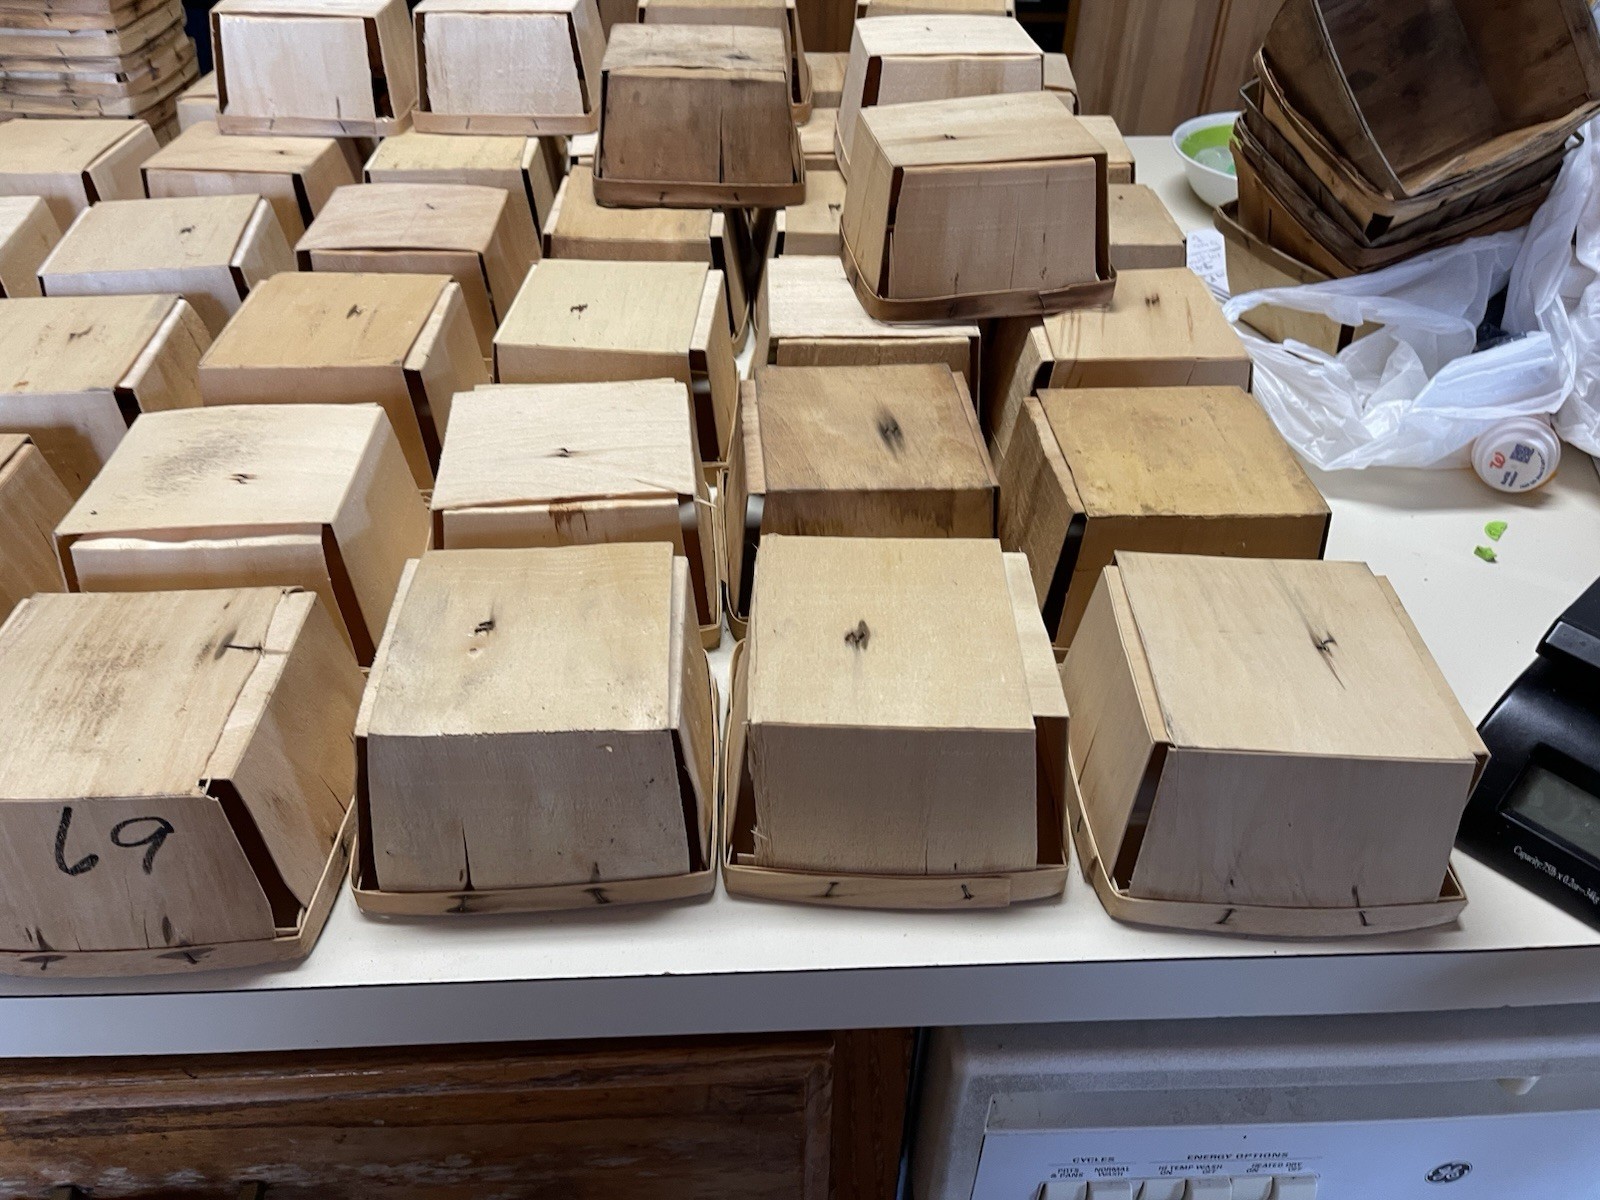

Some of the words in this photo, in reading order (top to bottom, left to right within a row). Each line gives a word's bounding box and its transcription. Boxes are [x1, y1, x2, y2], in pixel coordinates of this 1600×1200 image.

[55, 806, 175, 876] 69
[1072, 1156, 1115, 1164] CYCLES
[1187, 1153, 1233, 1161] ENERGY
[1235, 1152, 1289, 1160] OPTIONS
